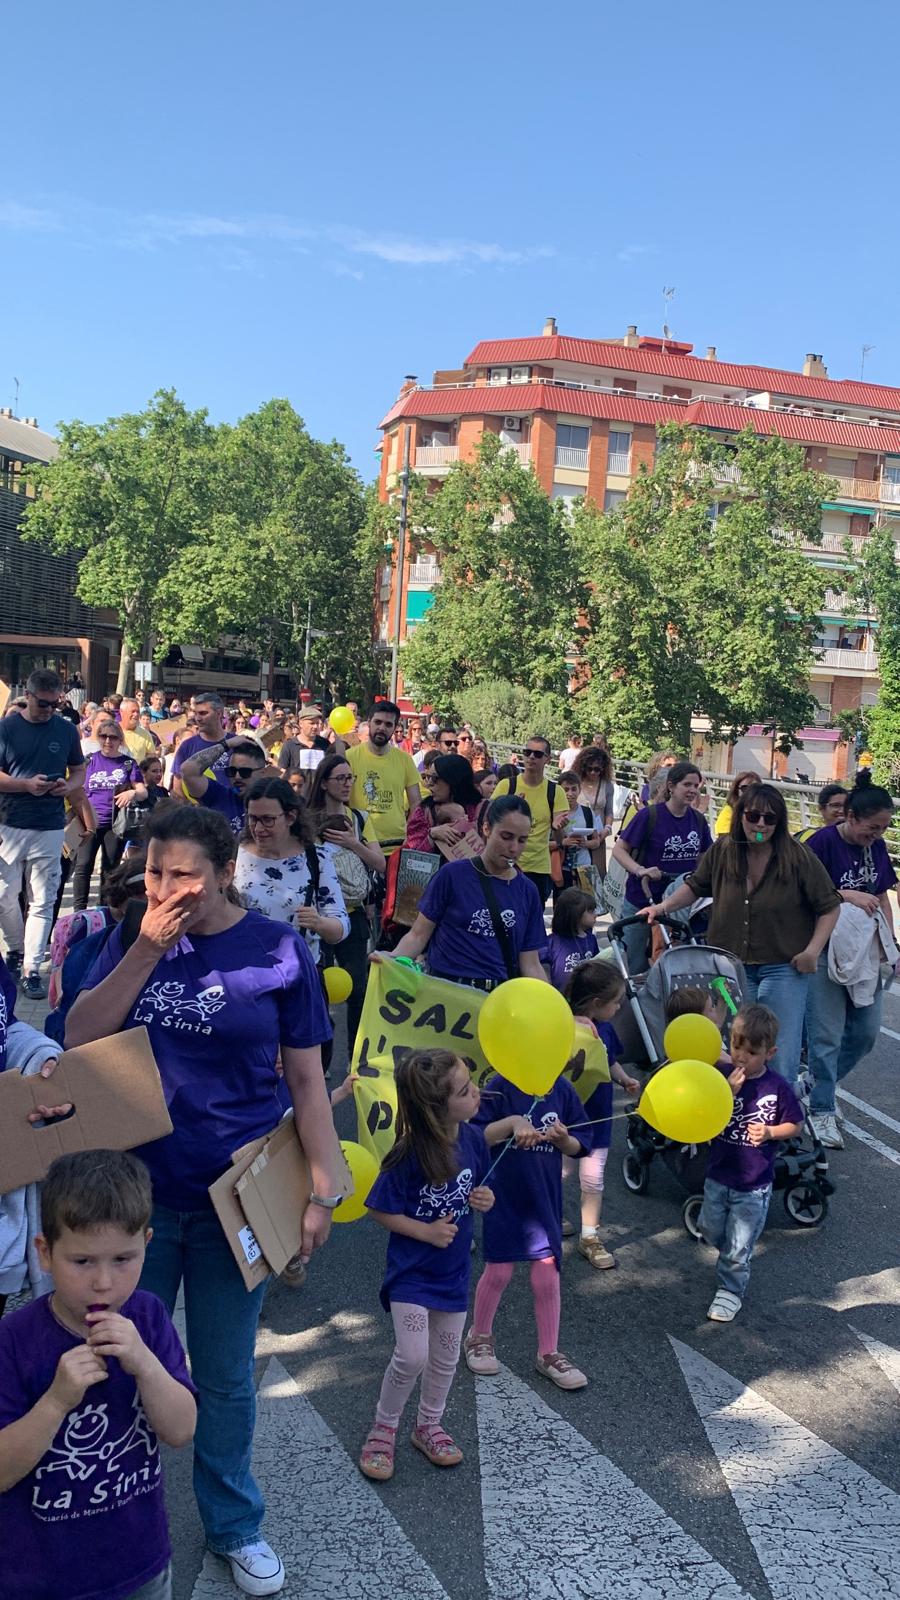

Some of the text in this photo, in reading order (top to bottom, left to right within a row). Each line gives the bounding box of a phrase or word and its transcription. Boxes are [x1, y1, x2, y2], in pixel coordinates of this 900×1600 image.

[133, 1008, 213, 1035] La Sínia
[379, 989, 474, 1040] SAL
[415, 1206, 433, 1217] La
[32, 1486, 73, 1510] La
